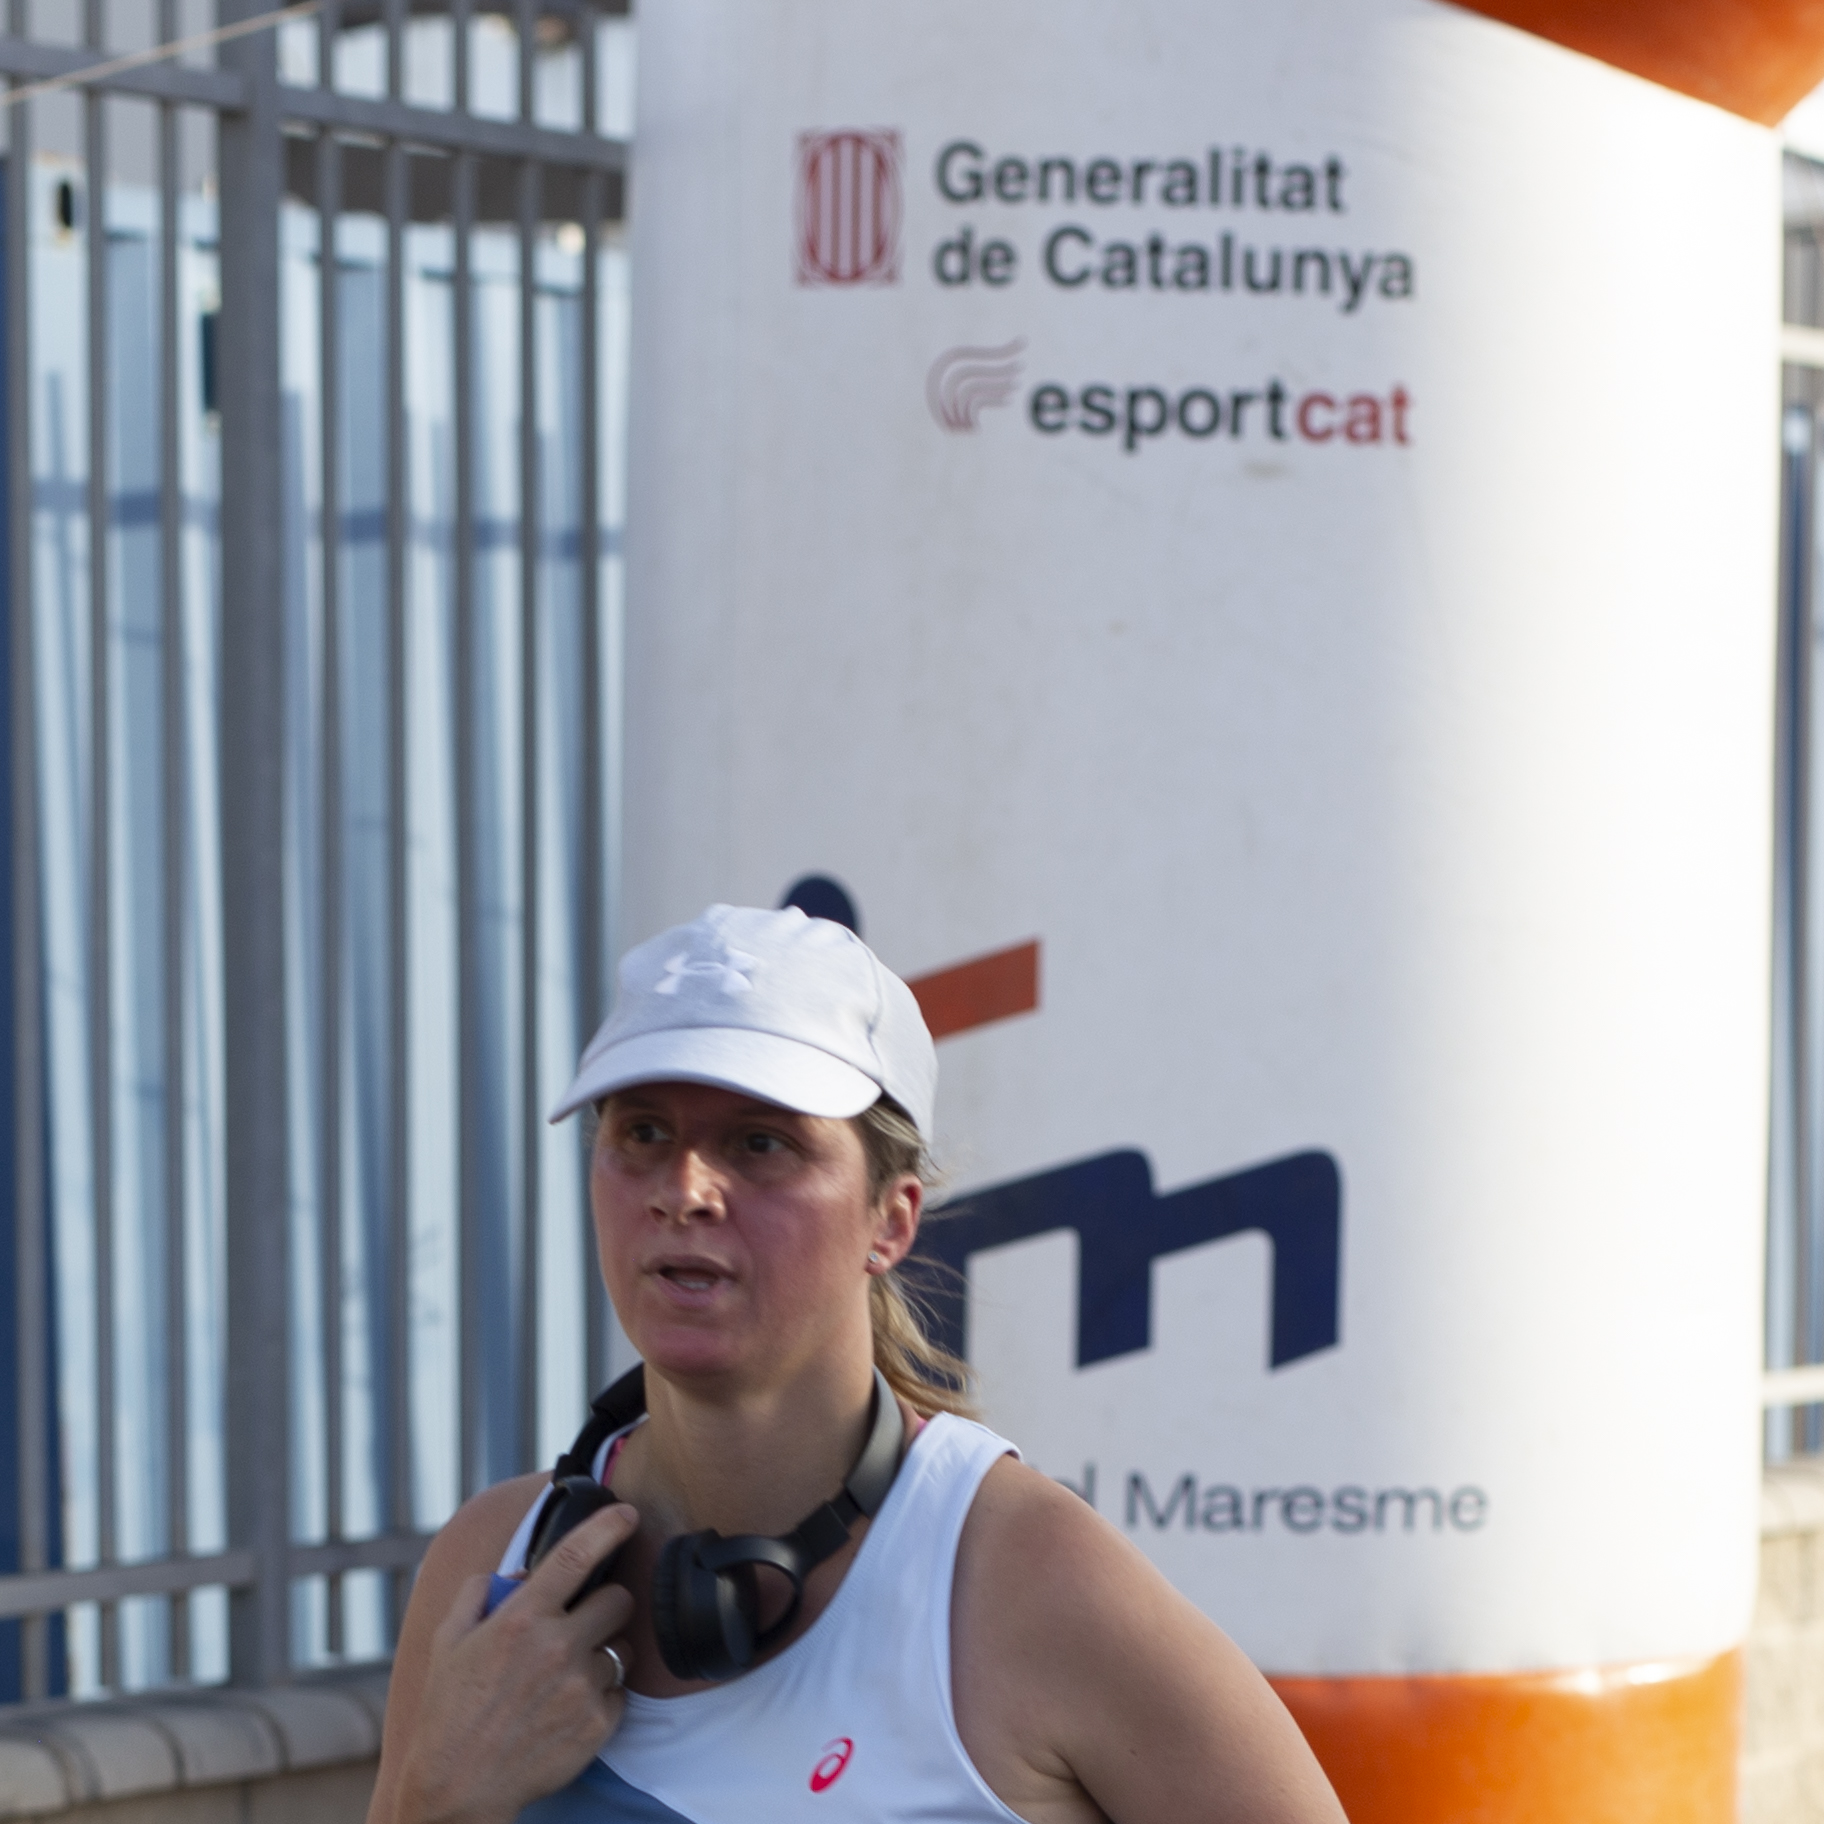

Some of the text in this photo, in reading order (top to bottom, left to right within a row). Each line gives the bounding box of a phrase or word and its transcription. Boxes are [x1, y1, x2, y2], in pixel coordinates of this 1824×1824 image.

[934, 140, 1347, 213] Generalitat
[933, 225, 1416, 314] de Catalunya
[1028, 377, 1412, 455] esportcat
[1124, 1468, 1489, 1534] Maresme
